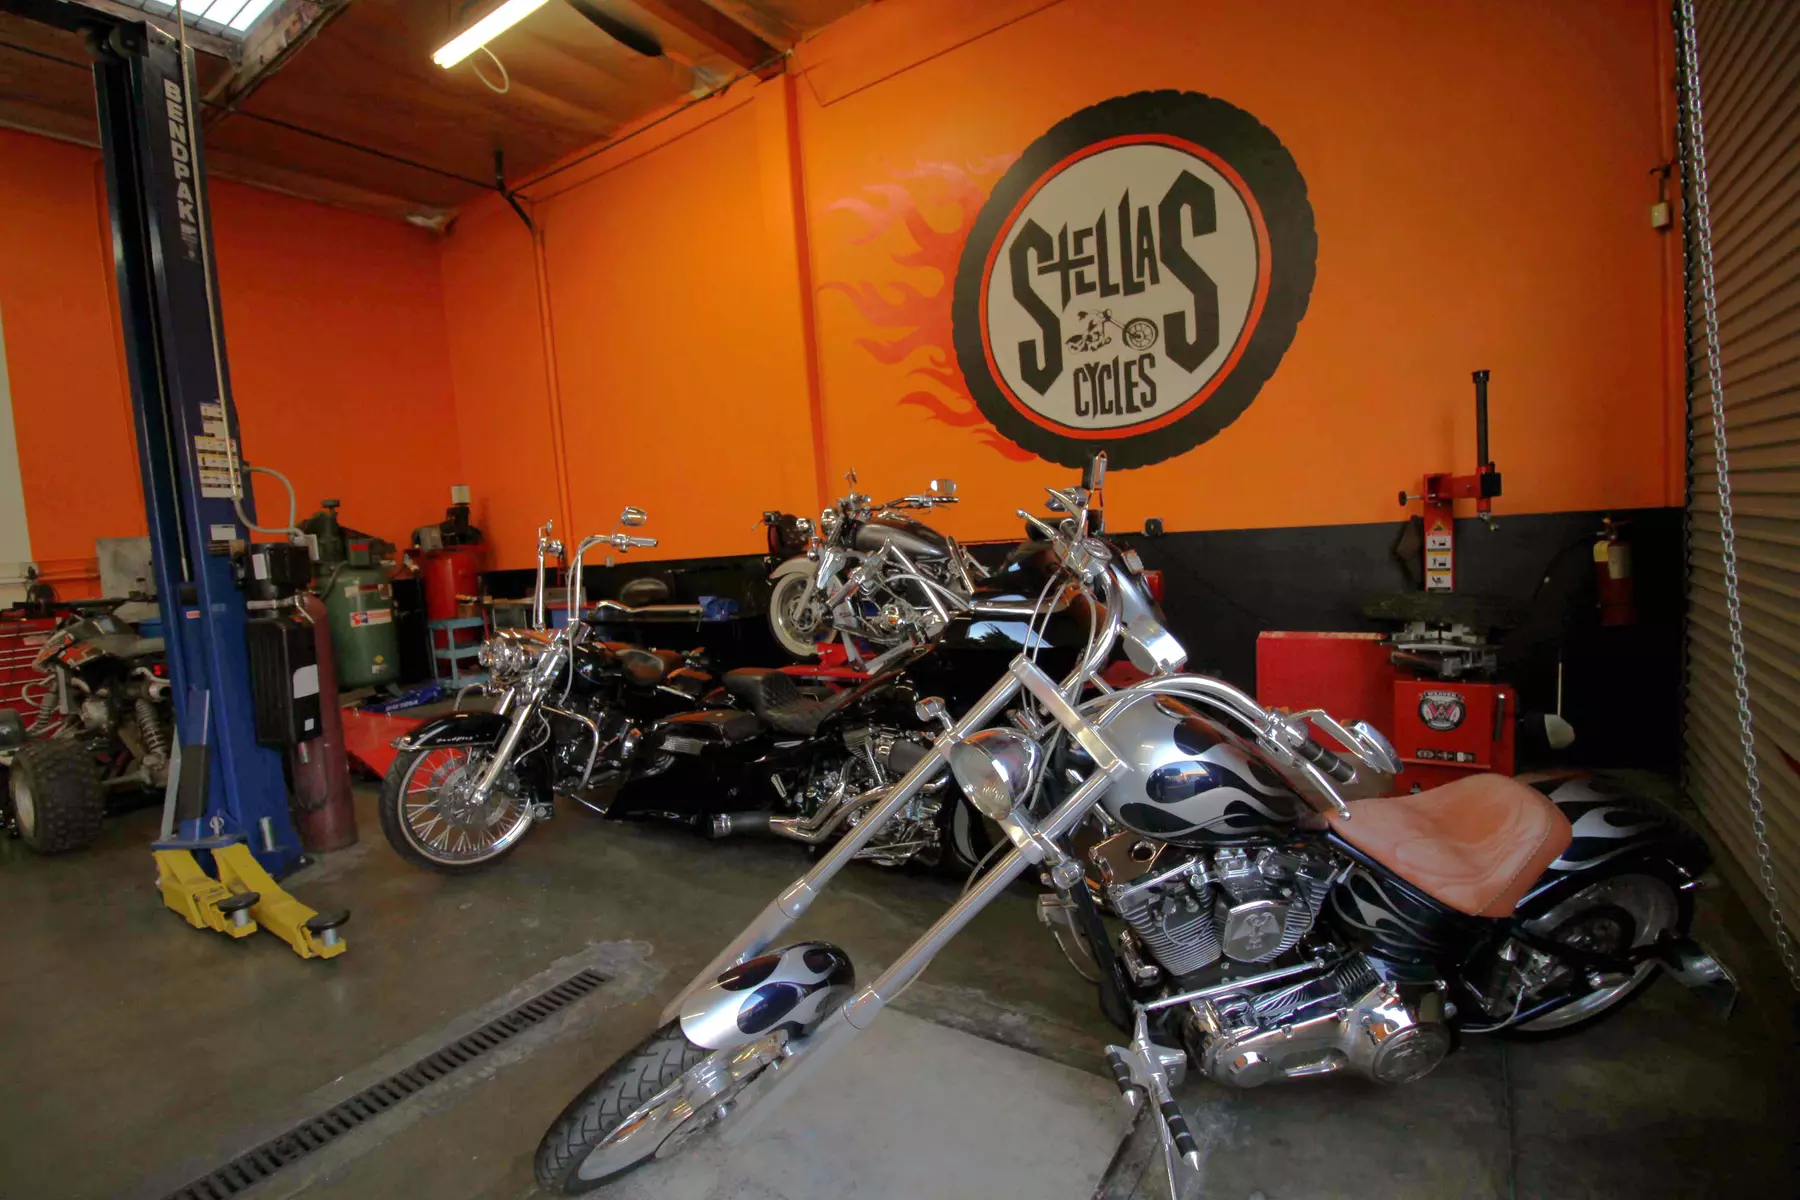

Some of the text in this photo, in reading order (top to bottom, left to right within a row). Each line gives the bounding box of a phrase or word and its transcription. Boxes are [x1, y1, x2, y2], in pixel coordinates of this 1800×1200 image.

[163, 78, 196, 223] BENDPAK
[1009, 169, 1220, 396] STELLAS
[1072, 352, 1157, 419] CYCLES
